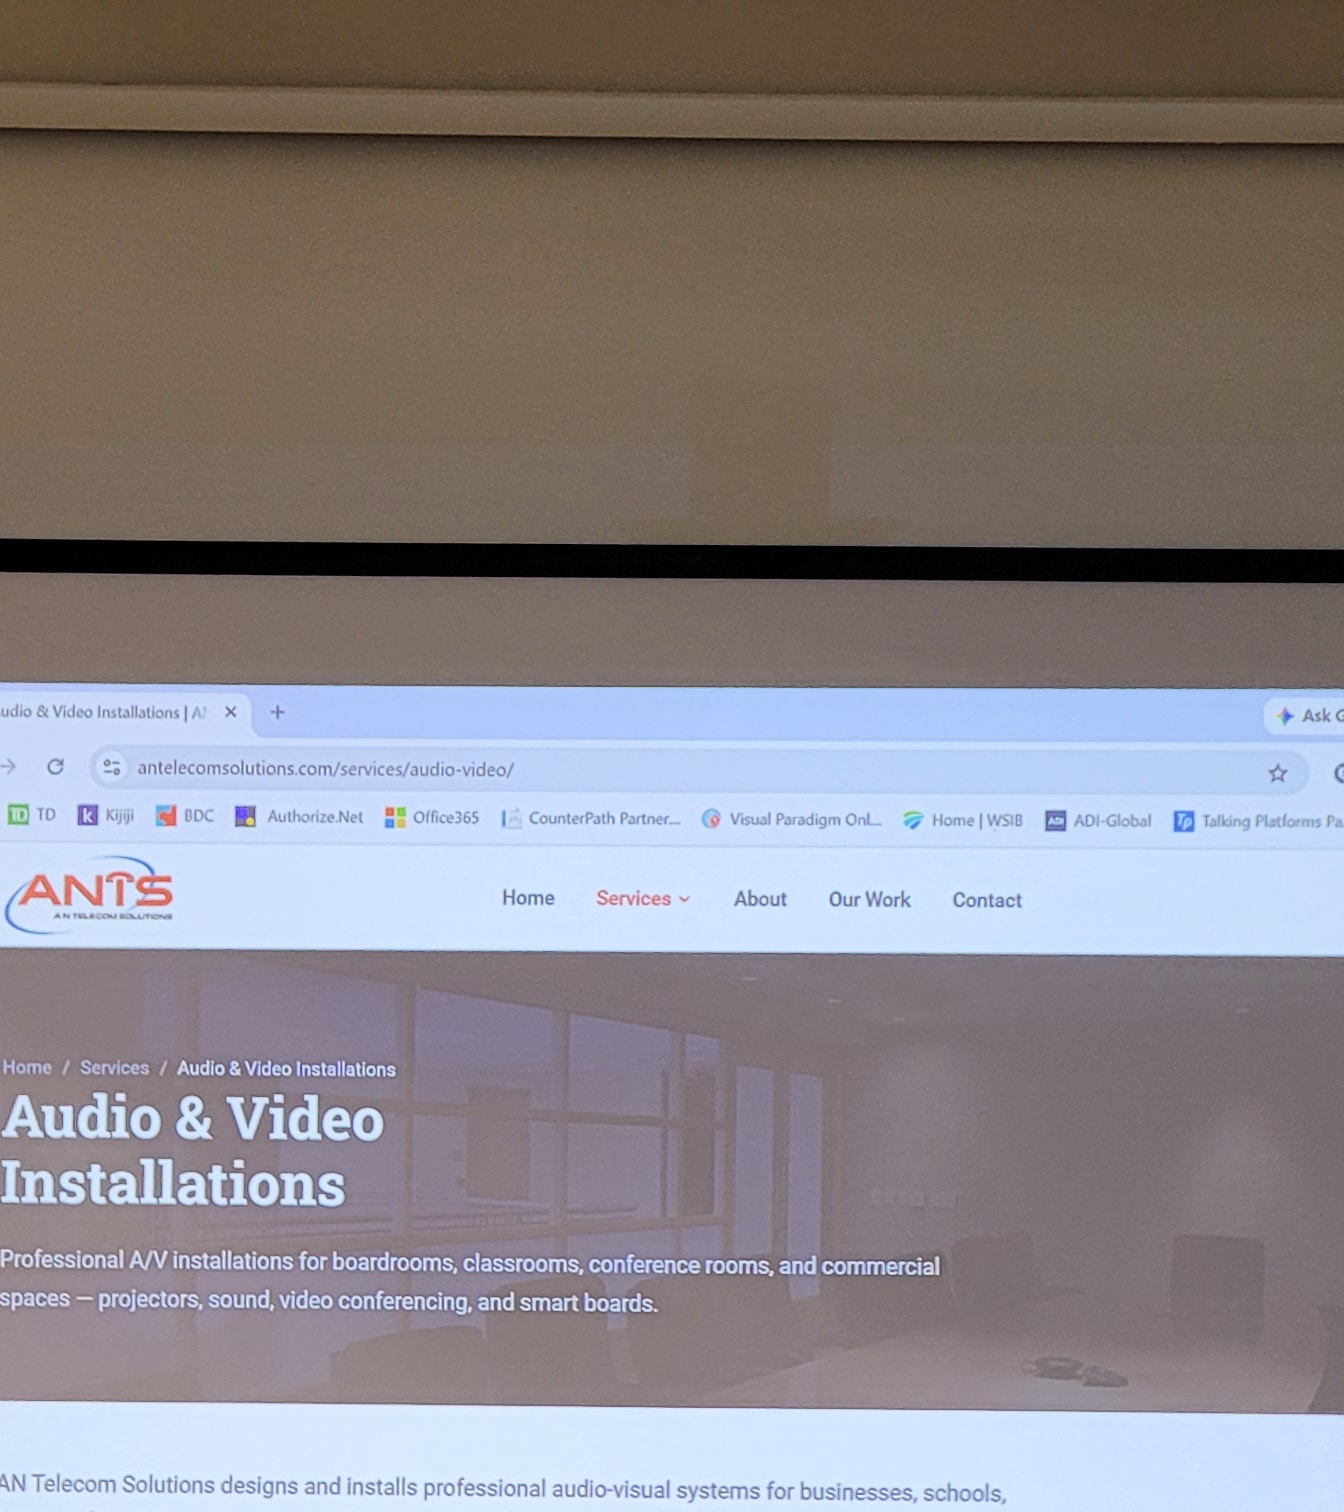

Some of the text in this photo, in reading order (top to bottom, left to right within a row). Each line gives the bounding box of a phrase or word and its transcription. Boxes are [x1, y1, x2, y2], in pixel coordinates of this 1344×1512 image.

[36, 704, 49, 718] &
[53, 703, 93, 719] Video
[98, 704, 180, 720] Installations
[1302, 707, 1331, 723] Ask
[138, 759, 514, 779] antelecomsolutions.com/services/audio-video/
[37, 808, 56, 822] TD
[106, 808, 134, 826] Kijiji
[185, 809, 214, 823] BDC
[268, 809, 363, 824] Authorize.Net
[413, 810, 479, 825] Office365
[529, 811, 615, 825] CounterPath
[730, 811, 771, 827] Visual
[776, 812, 841, 830] Paradigm
[933, 813, 975, 827] Home
[987, 813, 1023, 828] WSIB
[1074, 813, 1151, 828] ADI-Global
[1203, 814, 1251, 832] Talking
[1255, 812, 1322, 829] Platforms
[17, 871, 173, 907] ANTS
[503, 889, 555, 906] Home
[597, 890, 671, 906] Services
[734, 889, 787, 907] About
[830, 890, 911, 908] Our Work
[953, 892, 1022, 908] Contact
[73, 912, 117, 920] TELECOM
[120, 913, 173, 921] SOLUTIONS
[3, 1060, 51, 1075] Home
[81, 1059, 149, 1076] Services
[177, 1059, 225, 1076] Audio
[229, 1060, 241, 1076] &
[245, 1059, 292, 1077] Video
[297, 1060, 396, 1078] Installations
[2, 1092, 383, 1142] Audio & Video
[1, 1157, 344, 1208] Installations
[0, 1248, 940, 1277] Professional A/V installations for boardrooms, classrooms, conference rooms, and commercial
[0, 1292, 70, 1312] spaces
[99, 1288, 203, 1313] projectors,
[209, 1288, 274, 1312] sound,
[279, 1289, 333, 1309] video
[339, 1289, 472, 1315] conferencing,
[478, 1290, 514, 1312] and
[520, 1294, 579, 1312] smart
[584, 1292, 658, 1313] boards.
[32, 1473, 116, 1494] Telecom
[122, 1473, 215, 1494] Solutions
[221, 1474, 298, 1499] designs
[305, 1475, 341, 1496] and
[348, 1476, 417, 1497] installs
[424, 1477, 545, 1503] professional
[553, 1478, 670, 1500] audio-visual
[677, 1482, 760, 1505] systems
[767, 1480, 795, 1500] for
[801, 1480, 918, 1504] businesses,
[924, 1482, 1006, 1505] schools,
